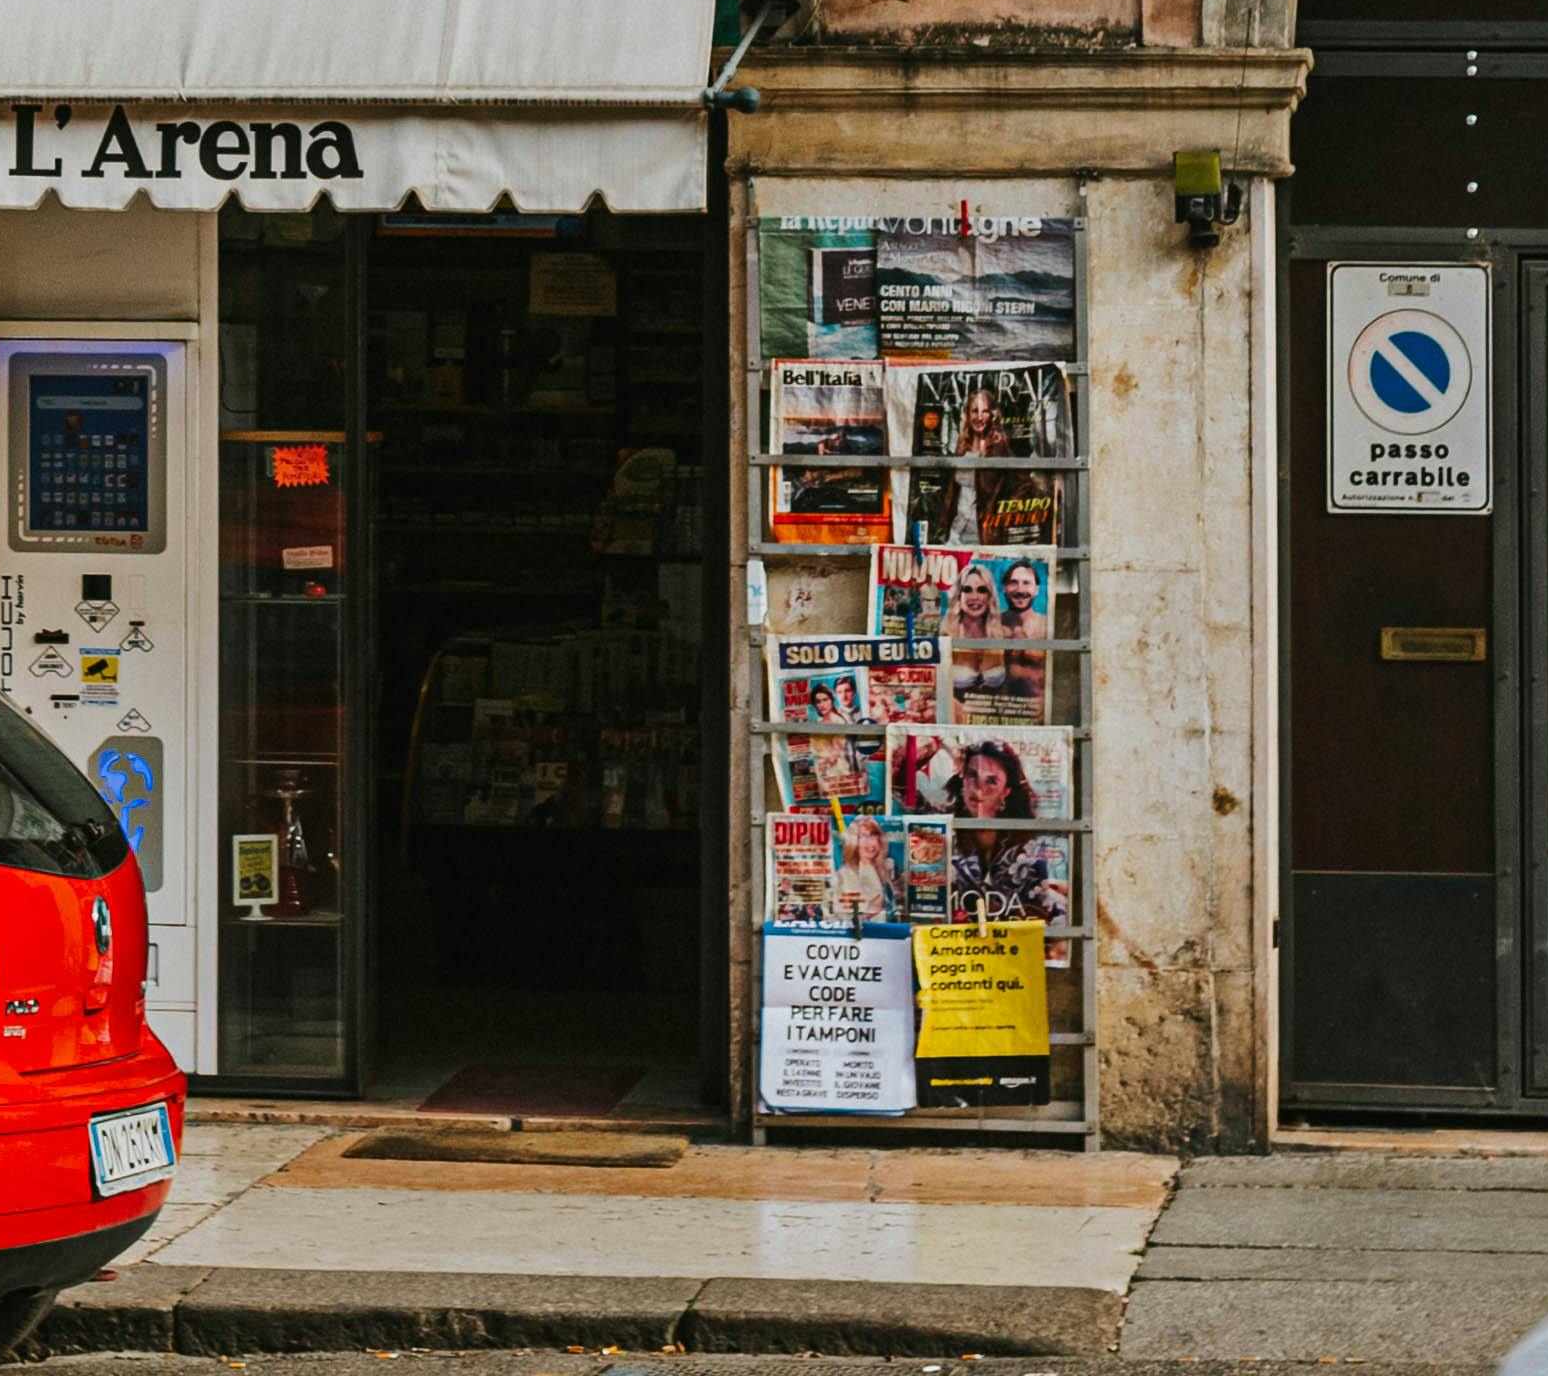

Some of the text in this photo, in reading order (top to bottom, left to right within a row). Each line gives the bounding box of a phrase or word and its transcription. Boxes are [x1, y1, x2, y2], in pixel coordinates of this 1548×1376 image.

[8, 104, 364, 180] L'Arena
[1379, 272, 1441, 283] Comune di
[880, 285, 920, 297] CENTO
[880, 300, 906, 312] CON
[909, 300, 949, 313] MARIO
[994, 301, 1035, 315] STERN
[783, 369, 863, 386] Bell'Italia
[1370, 442, 1449, 462] passo
[1349, 466, 1471, 487] carrabile
[997, 497, 1051, 514] TEMPO
[786, 644, 840, 665] SOLO
[843, 643, 873, 662] UN
[930, 927, 1008, 940] Compr su
[806, 944, 861, 961] COVID
[930, 943, 1019, 956] Amazon.it e
[784, 964, 883, 982] E VACANZE
[931, 960, 984, 976] paga in
[931, 977, 1024, 992] contanti qui.
[809, 986, 856, 1002] CODE
[791, 1005, 874, 1023] PER FARE
[796, 1026, 876, 1044] TAMPONI
